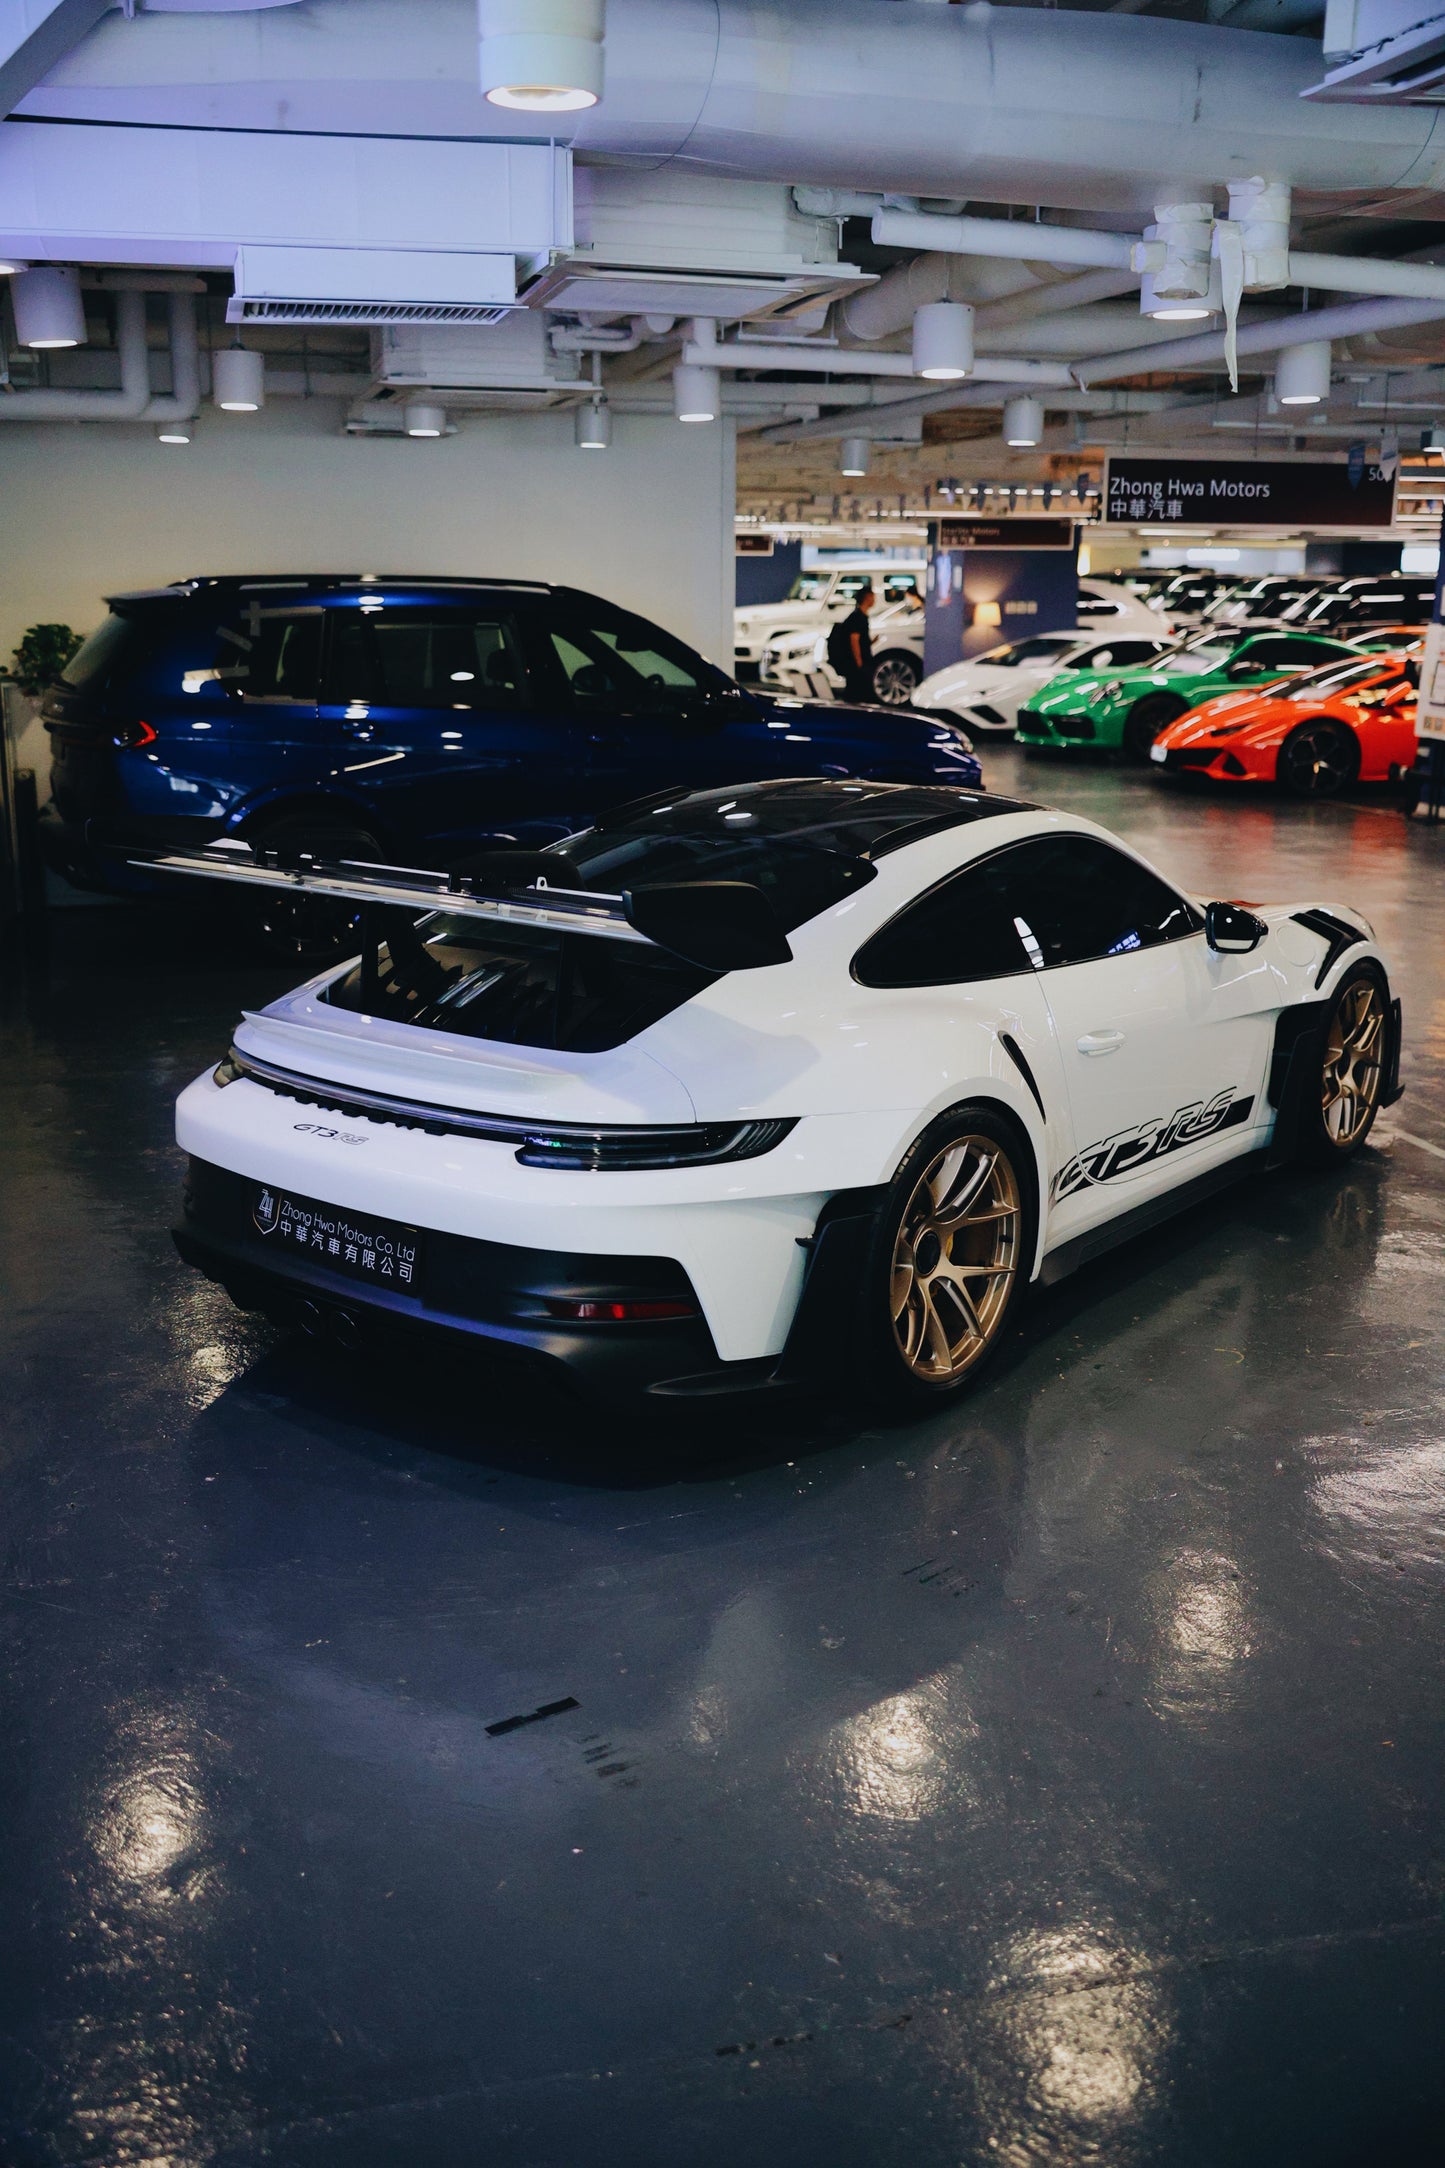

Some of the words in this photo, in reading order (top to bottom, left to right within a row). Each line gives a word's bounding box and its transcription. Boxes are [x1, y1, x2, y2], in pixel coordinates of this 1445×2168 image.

[1110, 477, 1163, 500] Zhong
[1168, 479, 1205, 497] Hwa
[1210, 479, 1271, 498] Motors
[1111, 498, 1184, 520] 中華汽車
[280, 1219, 413, 1283] 中華汽車有限公司
[281, 1199, 312, 1227] Zhong
[313, 1212, 335, 1234] Hwa
[336, 1220, 373, 1248] Motors
[375, 1235, 394, 1255] Co.
[396, 1241, 416, 1262] Ltd
